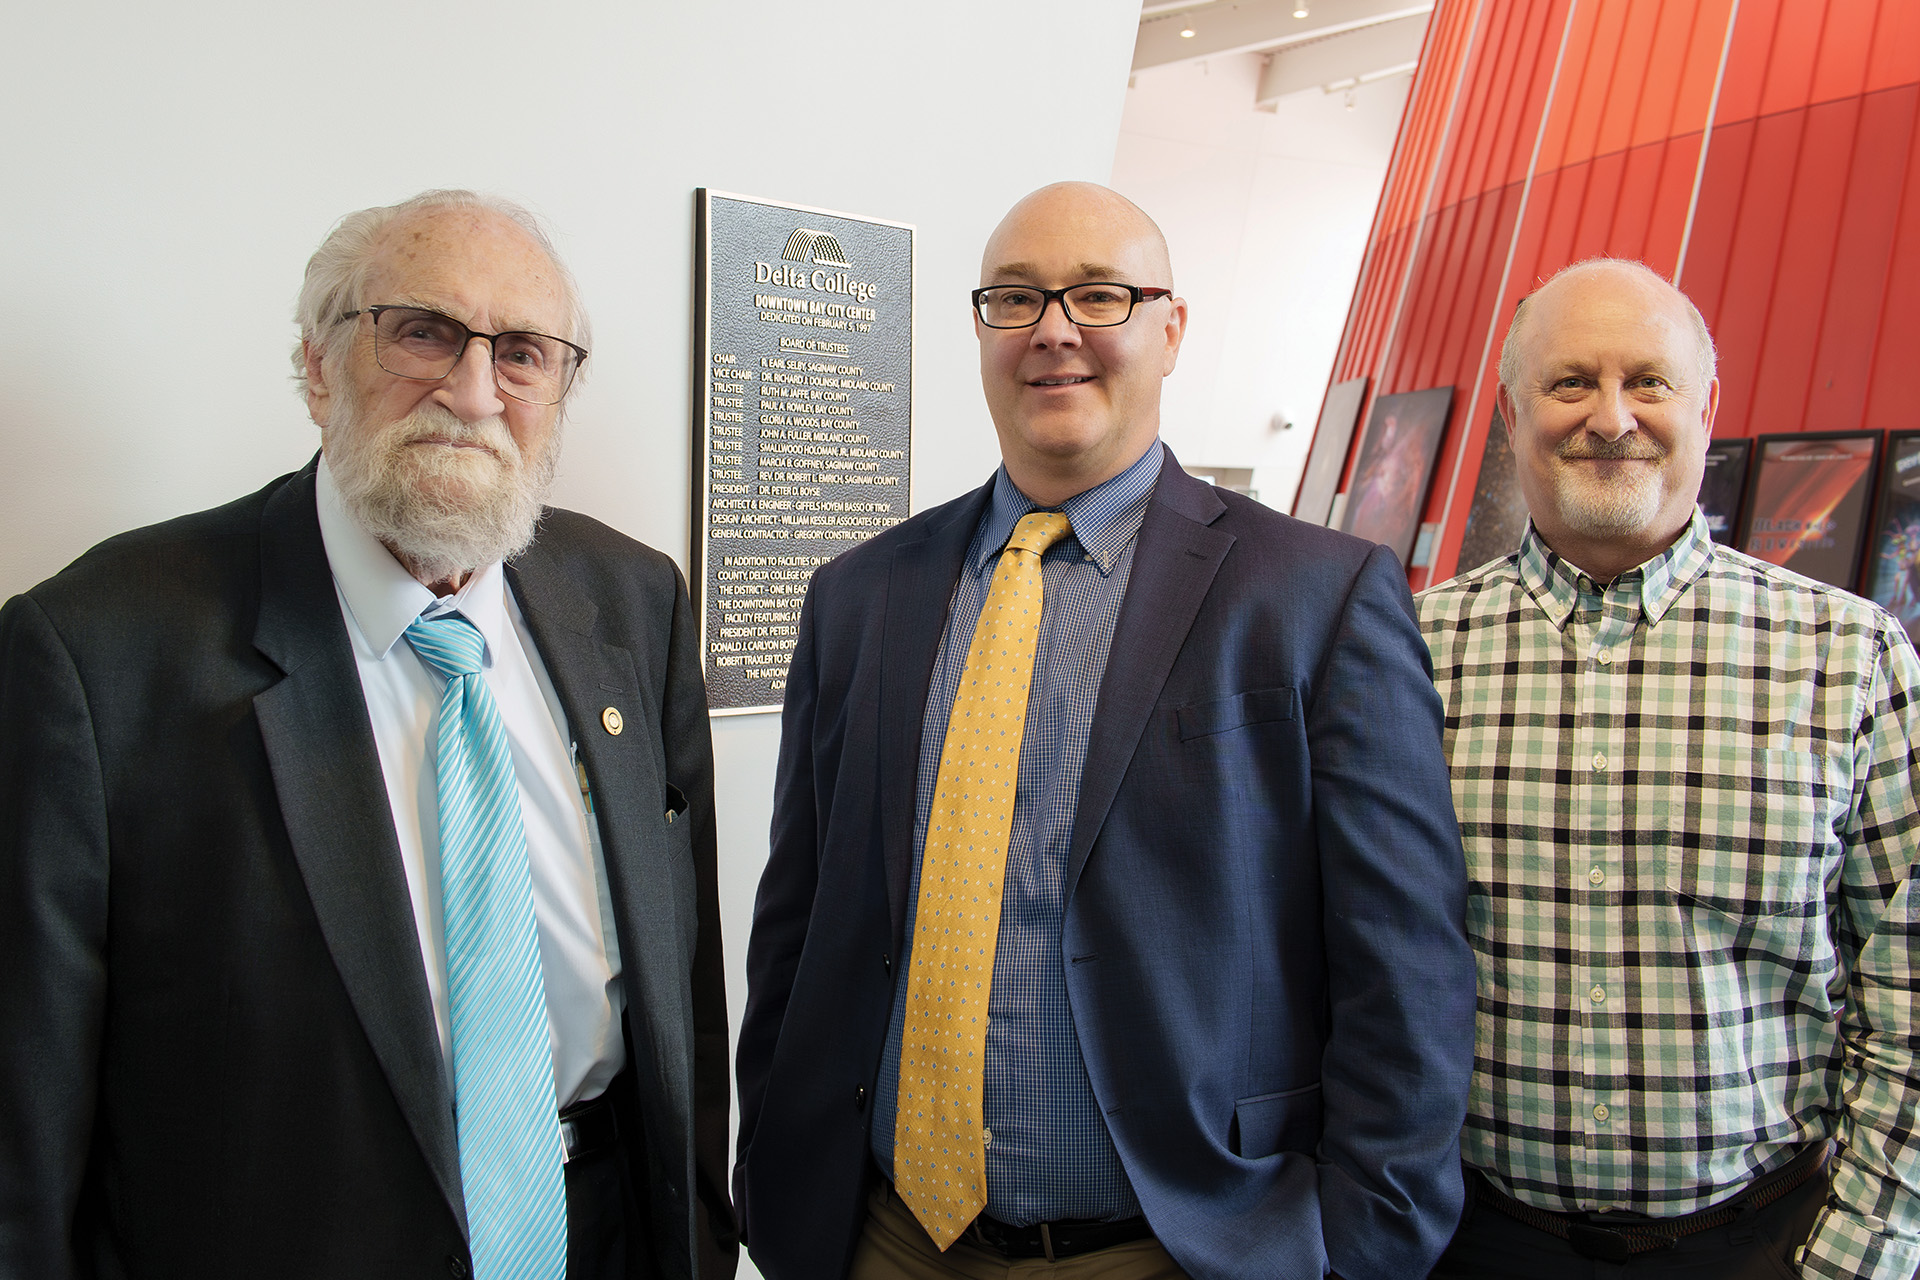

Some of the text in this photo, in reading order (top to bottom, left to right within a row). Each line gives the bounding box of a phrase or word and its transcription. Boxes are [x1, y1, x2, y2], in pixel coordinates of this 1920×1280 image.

[755, 262, 876, 303] Delta College
[755, 294, 876, 321] DOWNTOWN BAY CITY CENTER
[760, 311, 800, 324] DEDICATED
[801, 316, 812, 326] ON
[814, 317, 848, 330] FEBRUARY
[856, 323, 871, 332] 1997
[780, 338, 848, 352] BOARD OF TRUSTEES
[713, 354, 736, 364] CHAIR
[769, 358, 785, 368] EARL
[807, 362, 836, 373] SAGINAW
[837, 365, 863, 376] COUNTY
[713, 368, 730, 378] VICE
[730, 369, 752, 380] CHAIR
[773, 373, 803, 384] RICHARD
[840, 380, 869, 390] MIDLAND
[870, 383, 895, 392] COUNTY
[712, 382, 743, 394] TRUSTEE
[760, 386, 779, 396] RUTH
[810, 390, 823, 400] BAY
[823, 392, 850, 402] COUNTY
[712, 397, 743, 408] TRUSTEE
[760, 401, 777, 410] PAUL
[815, 404, 827, 413] BAY
[828, 406, 854, 416] COUNTY
[712, 411, 743, 422] TRUSTEE
[760, 415, 785, 424] GLORIA
[820, 419, 833, 428] BAY
[833, 420, 860, 430] COUNTY
[712, 426, 743, 436] TRUSTEE
[760, 429, 779, 439] JOHN
[813, 432, 843, 442] MIDLAND
[843, 434, 869, 444] COUNTY
[712, 440, 743, 450] TRUSTEE
[759, 443, 803, 454] SMALLWOOD
[849, 448, 879, 458] MIDLAND
[879, 450, 904, 459] COUNTY
[712, 455, 742, 465] TRUSTEE
[759, 457, 786, 467] MARCIA
[825, 460, 854, 470] SAGINAW
[854, 462, 880, 472] COUNTY
[712, 470, 742, 479] TRUSTEE
[786, 472, 811, 482] ROBERT
[844, 475, 873, 484] SAGINAW
[874, 476, 899, 486] COUNTY
[712, 484, 749, 494] PRESIDENT
[771, 486, 791, 495] PETER
[799, 487, 820, 496] BOYSE
[712, 499, 750, 509] ARCHITECT
[758, 501, 791, 510] ENGINEER
[795, 501, 820, 511] GIFFELS
[821, 502, 843, 511] HOYEM
[845, 503, 864, 512] BASSO
[865, 503, 874, 512] OF
[875, 503, 890, 512] TROY
[712, 514, 738, 524] DESIGN
[740, 515, 778, 524] ARCHITECT
[781, 515, 809, 525] WILLIAM
[810, 516, 835, 526] KESSLER
[837, 516, 872, 526] ASSOCIATES
[873, 518, 881, 526] OF
[711, 529, 743, 538] GENERAL
[743, 530, 788, 539] CONTRACTOR
[794, 530, 824, 539] GREGORY
[824, 531, 872, 539] CONSTRUCTION
[724, 557, 732, 565] IN
[733, 557, 766, 566] ADDITION
[767, 557, 777, 565] TO
[778, 557, 809, 565] FACILITIES
[810, 557, 820, 565] ON
[718, 571, 748, 581] COUNTY,
[749, 571, 769, 580] DELTA
[770, 571, 799, 580] COLLEGE
[719, 585, 733, 594] THE
[734, 585, 764, 594] DISTRICT
[770, 585, 785, 594] ONE
[718, 599, 804, 609] THE DOWNTOWN BAY CITY
[724, 613, 753, 623] FACILITY
[754, 612, 790, 622] FEATURING
[720, 627, 757, 637] PRESIDENT
[769, 626, 789, 636] PETER
[710, 642, 741, 652] DONALD
[748, 640, 778, 650] CARLYON
[716, 656, 743, 666] ROBERT
[744, 655, 772, 664] TRAXLER
[773, 654, 783, 664] TO
[746, 669, 759, 678] THE
